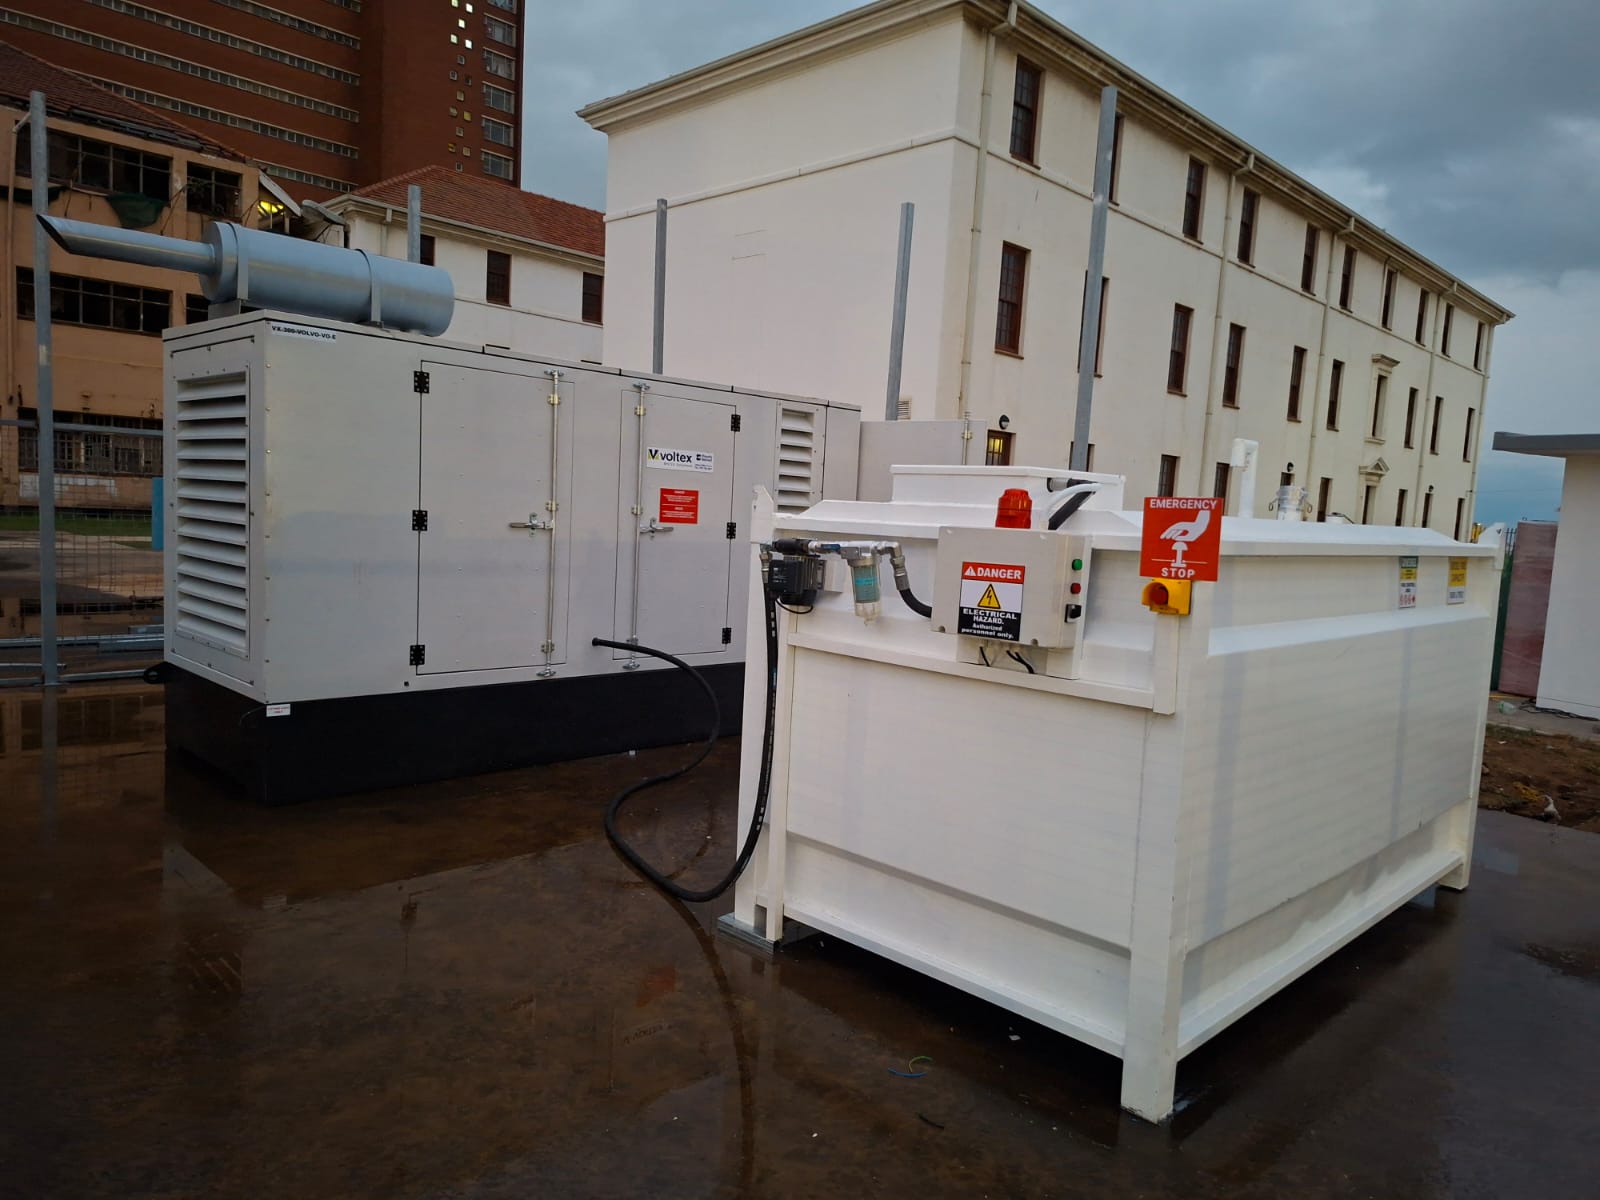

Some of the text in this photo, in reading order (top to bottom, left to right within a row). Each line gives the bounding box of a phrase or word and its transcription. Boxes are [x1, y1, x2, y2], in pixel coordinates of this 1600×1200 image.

[660, 451, 692, 463] voltex
[1150, 498, 1218, 510] EMERGENCY
[977, 567, 1022, 580] DANGER
[1161, 567, 1196, 579] STOP
[962, 608, 1017, 620] ELECTRICAL
[973, 616, 1005, 625] HAZARD.
[972, 623, 1003, 632] Authorized
[961, 628, 1015, 640] personnel only.
